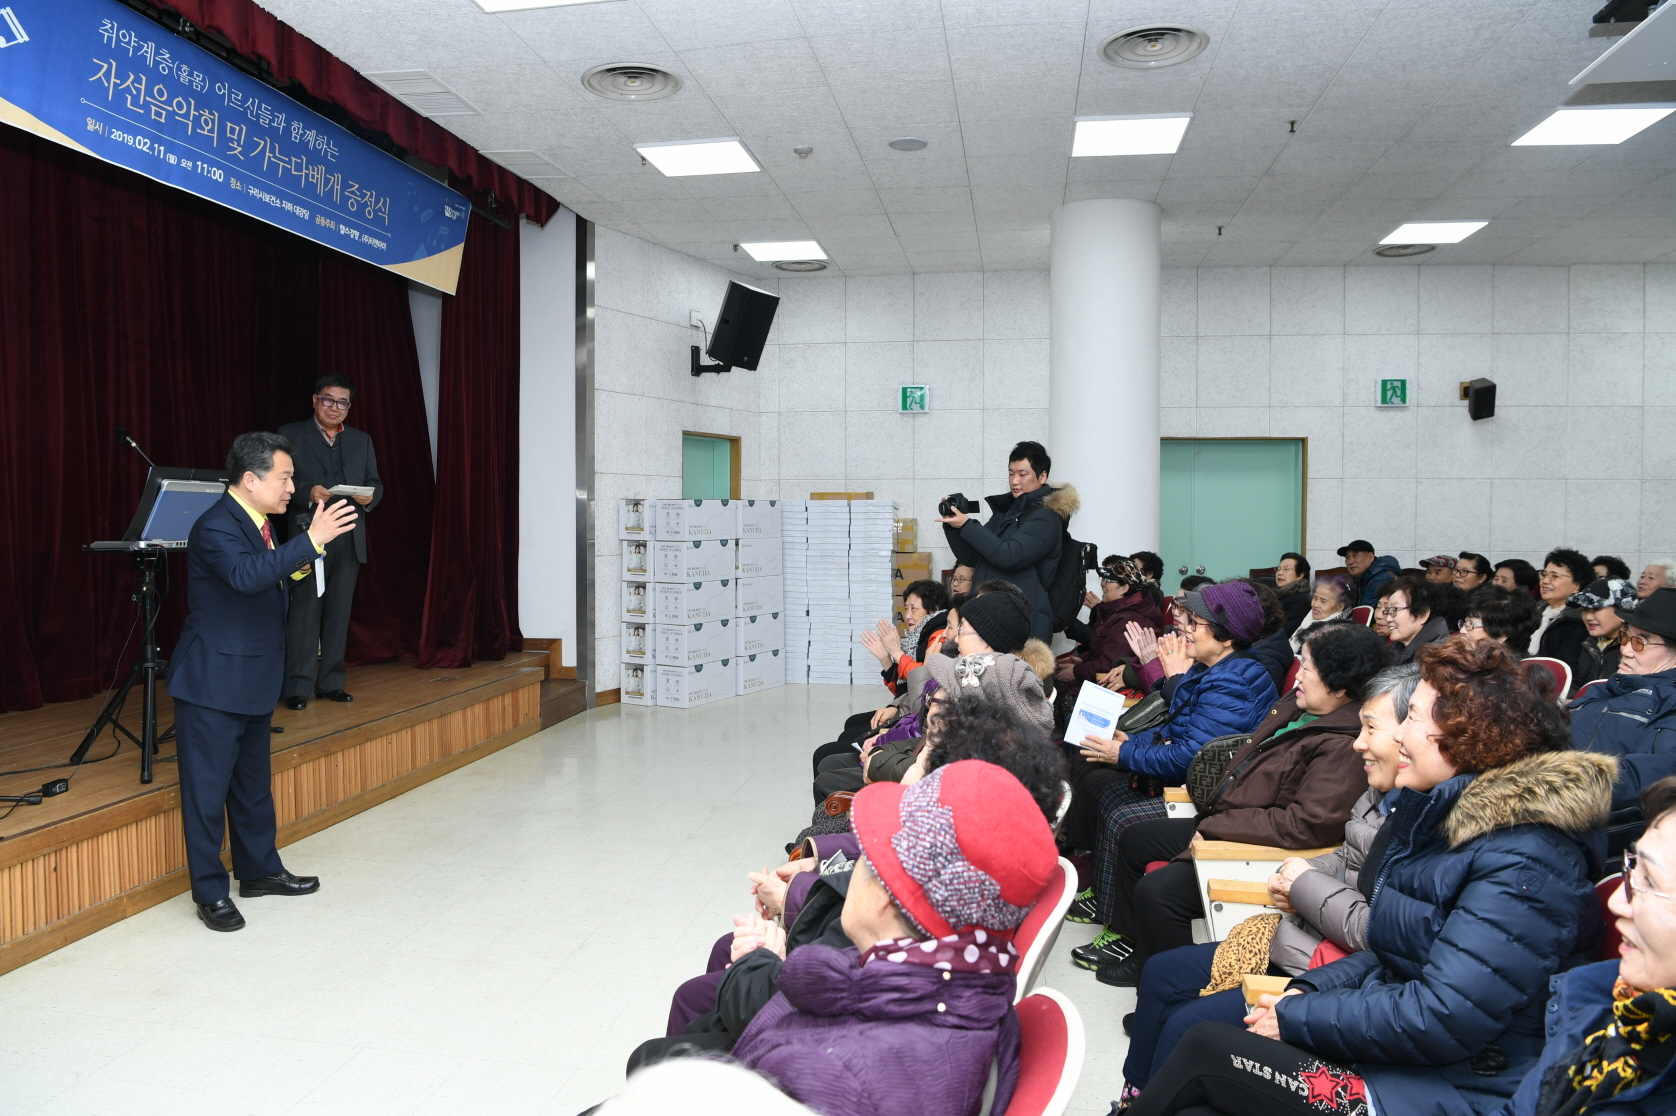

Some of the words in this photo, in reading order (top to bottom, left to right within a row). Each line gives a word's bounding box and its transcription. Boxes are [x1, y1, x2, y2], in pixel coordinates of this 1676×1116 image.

[89, 58, 218, 148] 자선음악회
[226, 121, 246, 160] 및
[250, 136, 342, 204] 가누다베개
[344, 180, 390, 226] 증정식
[99, 18, 209, 94] 취약계층(홀몸)
[215, 81, 286, 135] 어르신들과
[291, 120, 339, 162] 함께하는
[86, 117, 103, 135] 일시
[110, 128, 165, 159] 2019.02.11
[180, 158, 193, 171] 오전
[196, 161, 224, 183] 11:00
[229, 177, 242, 191] 장소
[247, 185, 281, 208] 구리시보건소
[281, 200, 293, 213] 지하
[293, 205, 310, 220] 대강당
[315, 214, 336, 231] 공동주최
[1230, 1054, 1273, 1080] STAR
